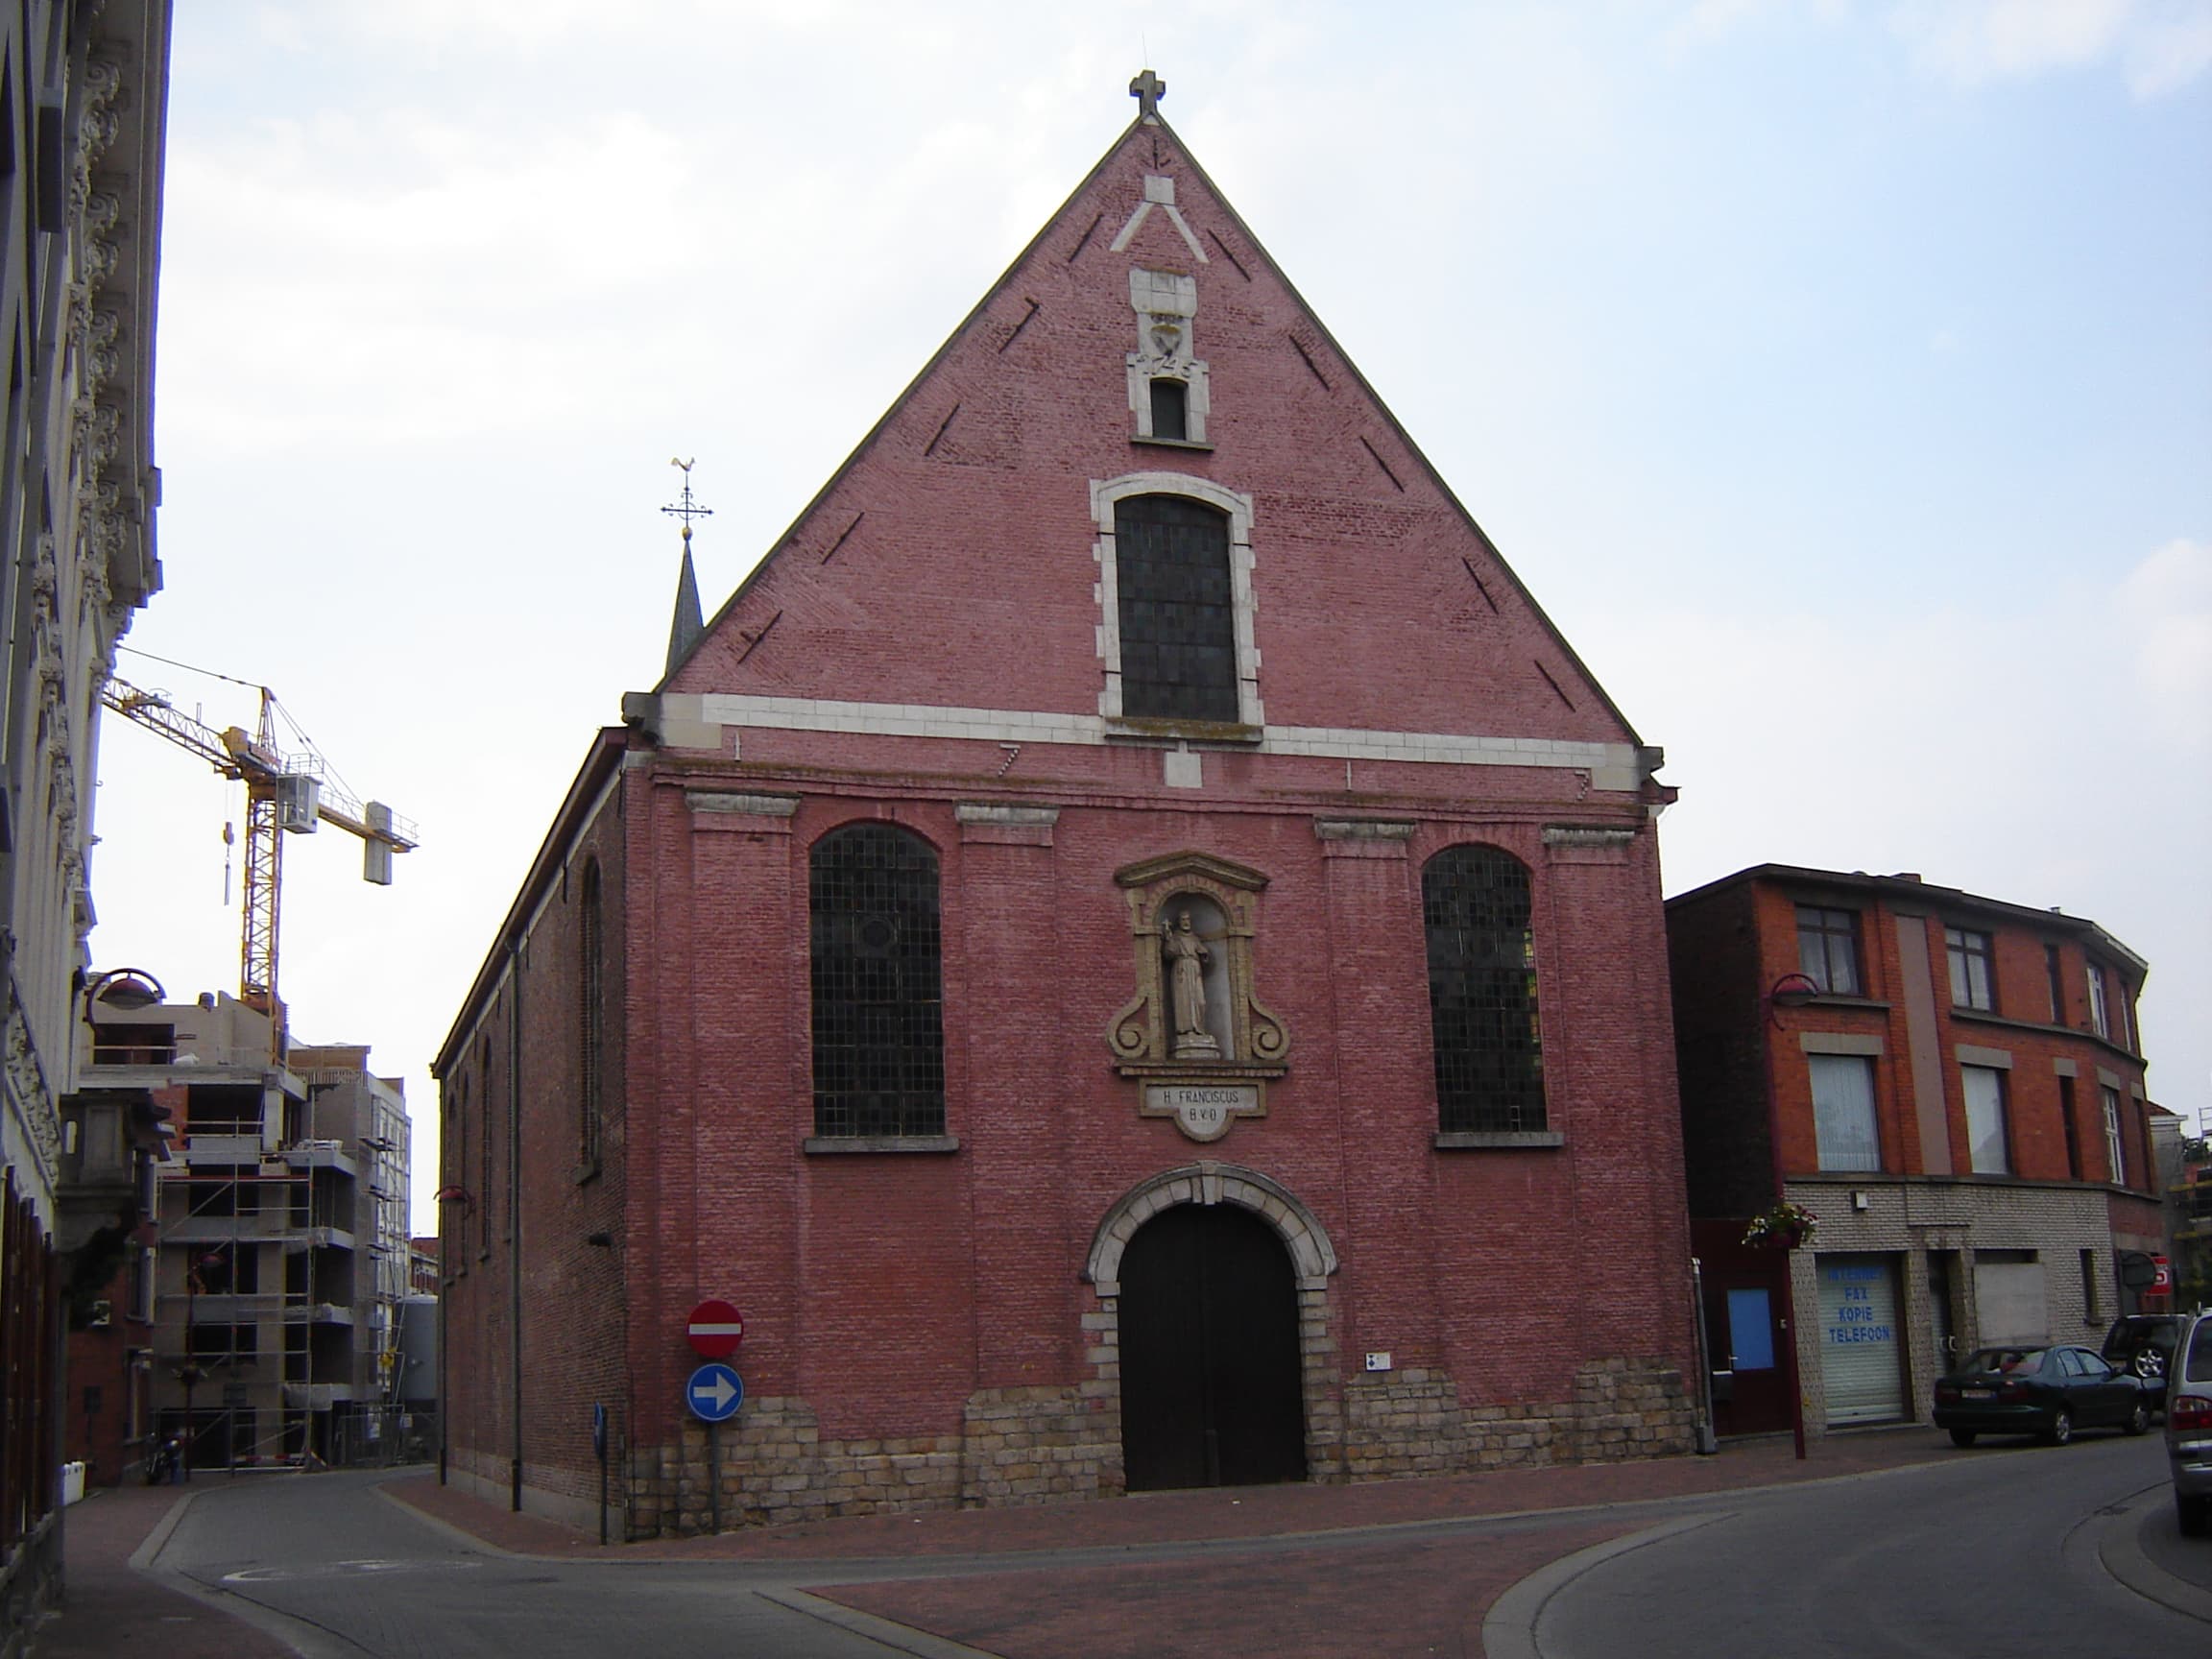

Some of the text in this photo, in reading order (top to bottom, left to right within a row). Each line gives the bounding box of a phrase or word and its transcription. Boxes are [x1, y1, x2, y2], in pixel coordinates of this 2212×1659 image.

[1179, 1091, 1238, 1103] FRANCISCUS
[1844, 1286, 1868, 1301] FAX
[1839, 1307, 1873, 1322] KOPIE
[1829, 1326, 1890, 1343] TELEFOON
